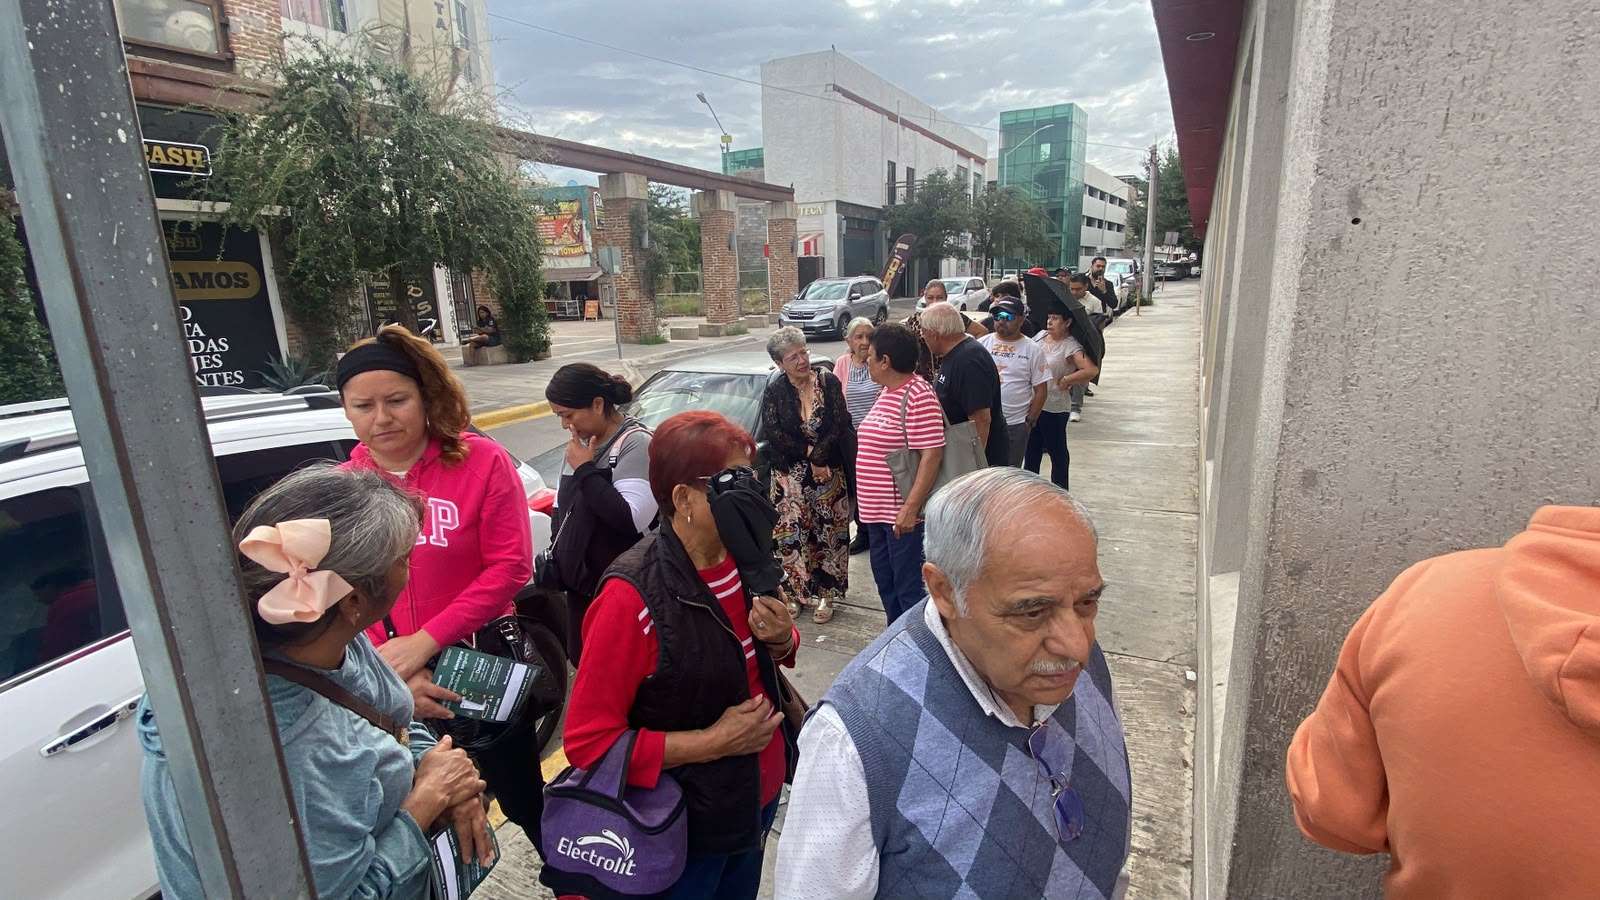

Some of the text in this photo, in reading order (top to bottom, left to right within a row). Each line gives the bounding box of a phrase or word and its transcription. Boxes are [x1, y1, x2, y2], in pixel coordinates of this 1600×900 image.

[188, 337, 229, 354] DAS
[415, 497, 460, 547] P
[557, 836, 637, 876] Electrolit
